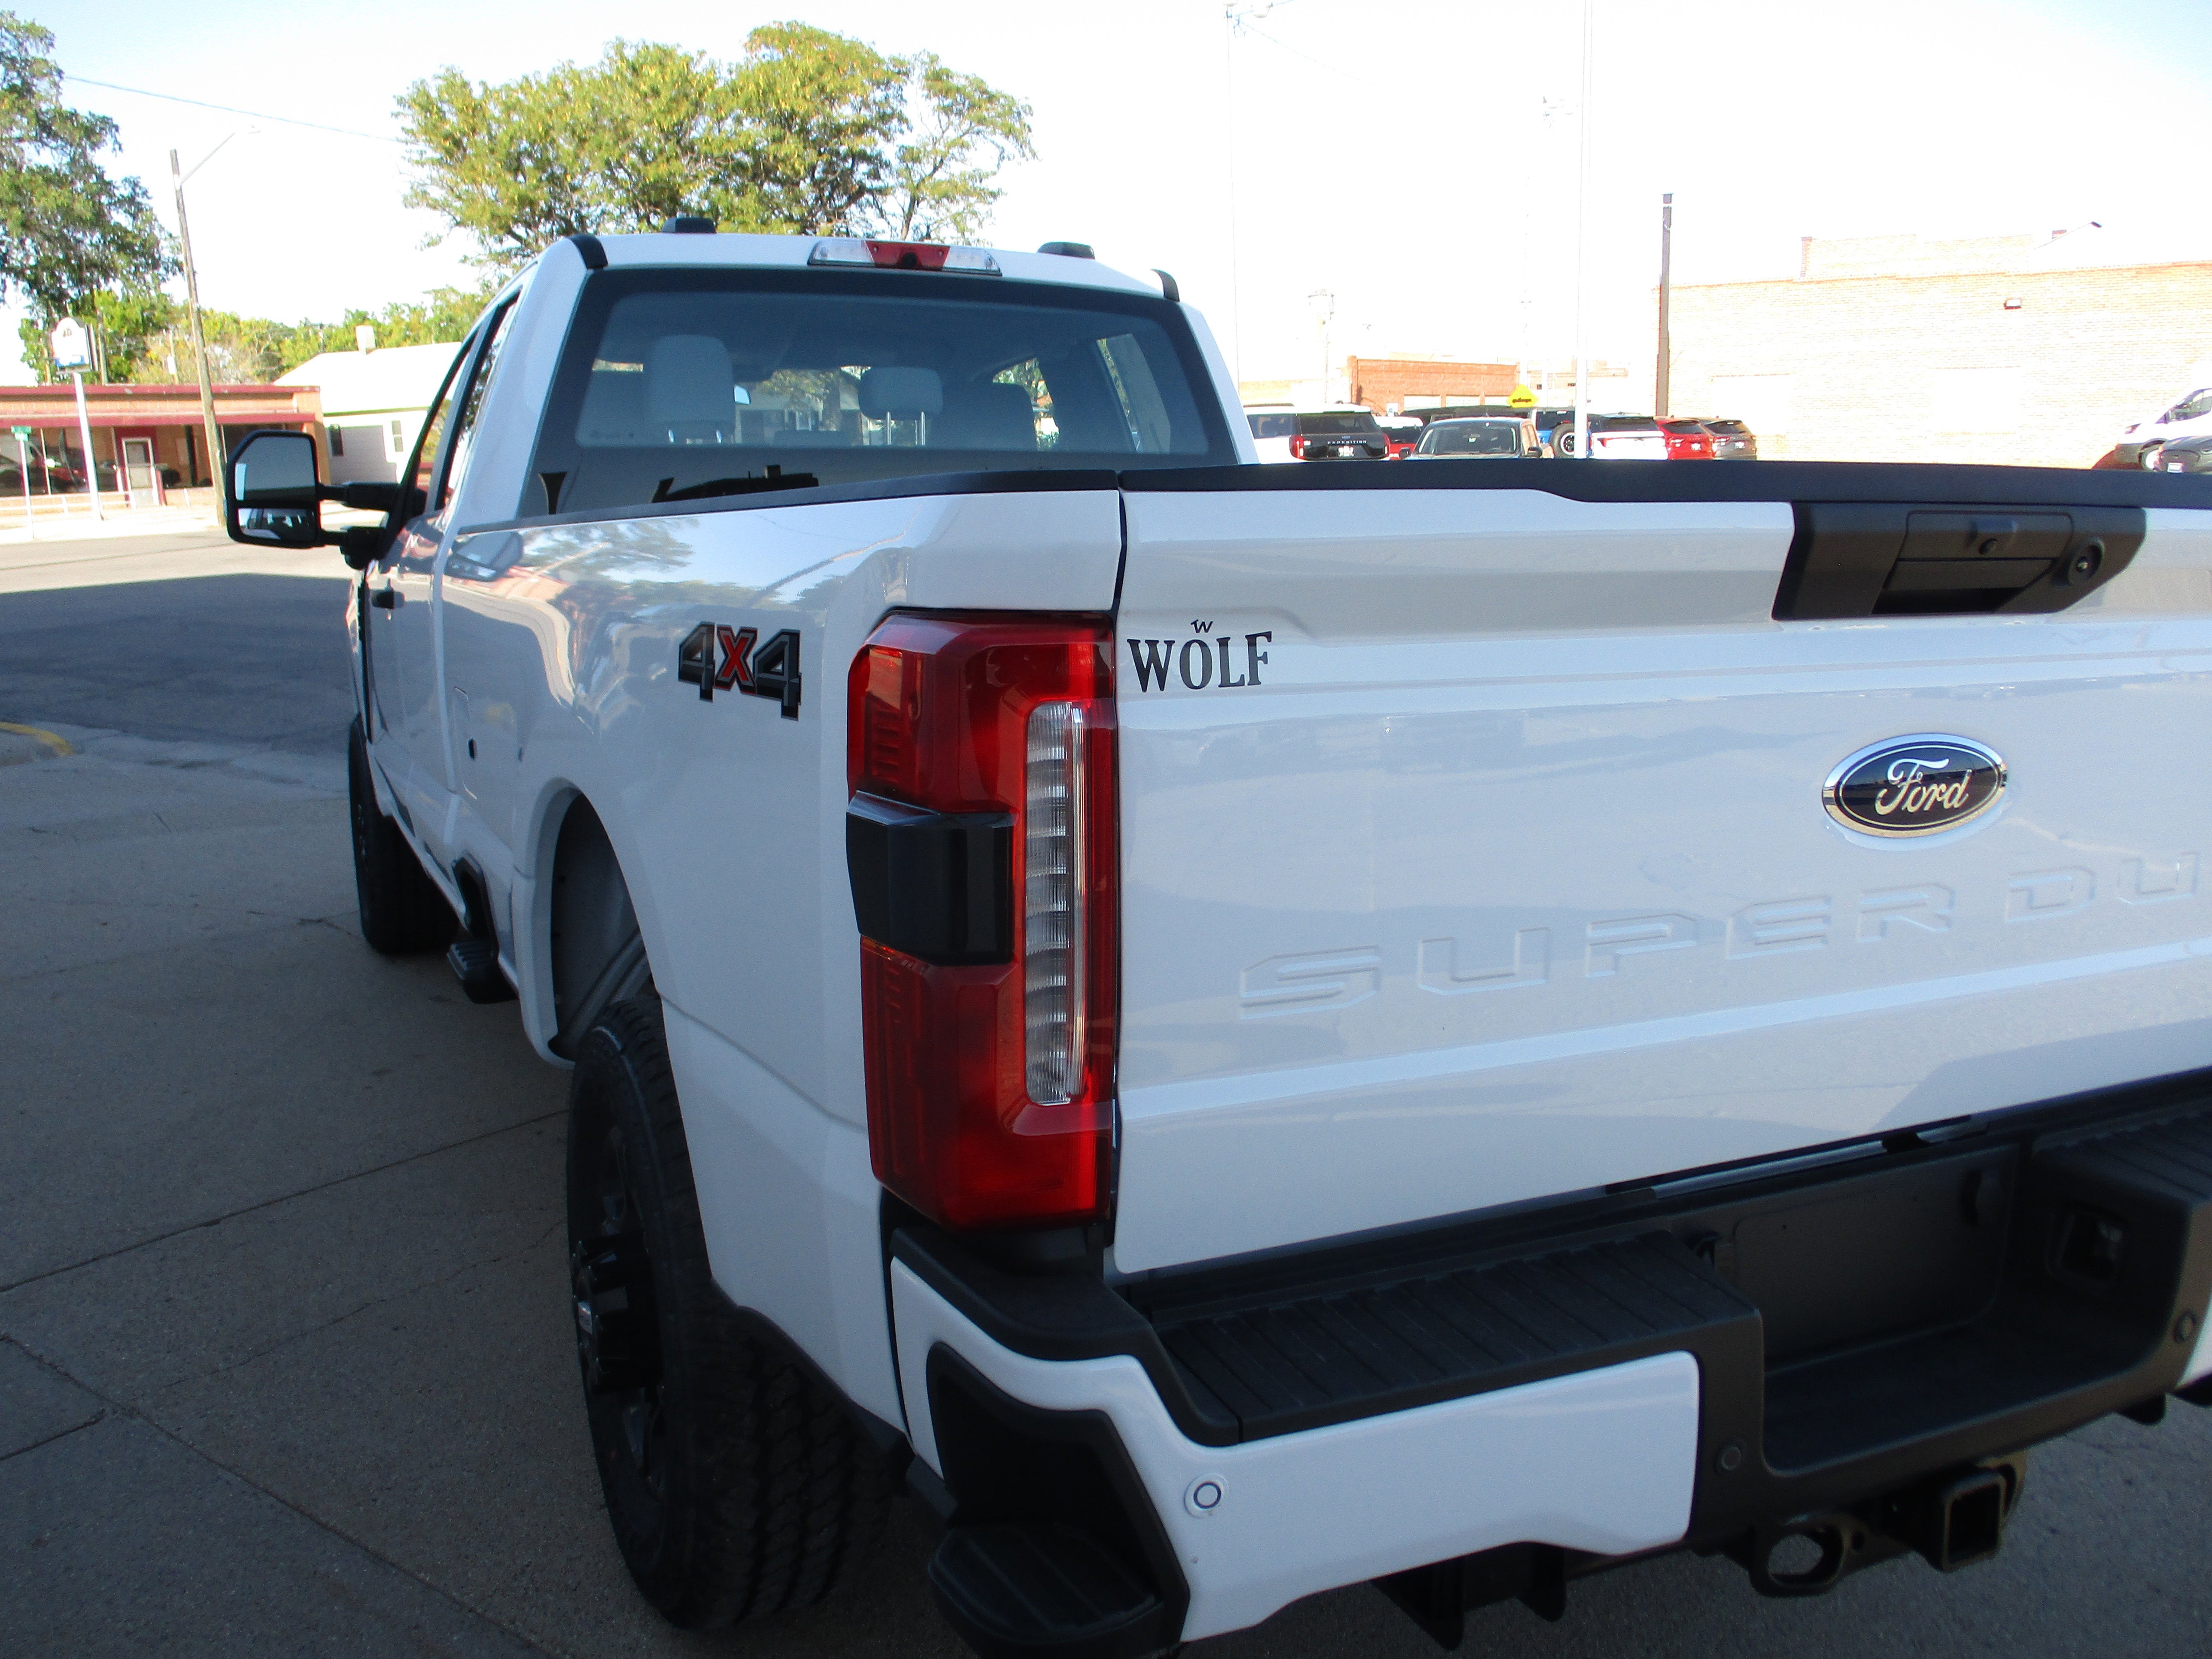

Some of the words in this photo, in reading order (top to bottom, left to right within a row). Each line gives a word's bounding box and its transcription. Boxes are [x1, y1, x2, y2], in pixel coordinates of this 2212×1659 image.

[1127, 631, 1272, 693] WOLF
[1875, 757, 1973, 815] Ford
[1240, 882, 1955, 1020] SUPER
